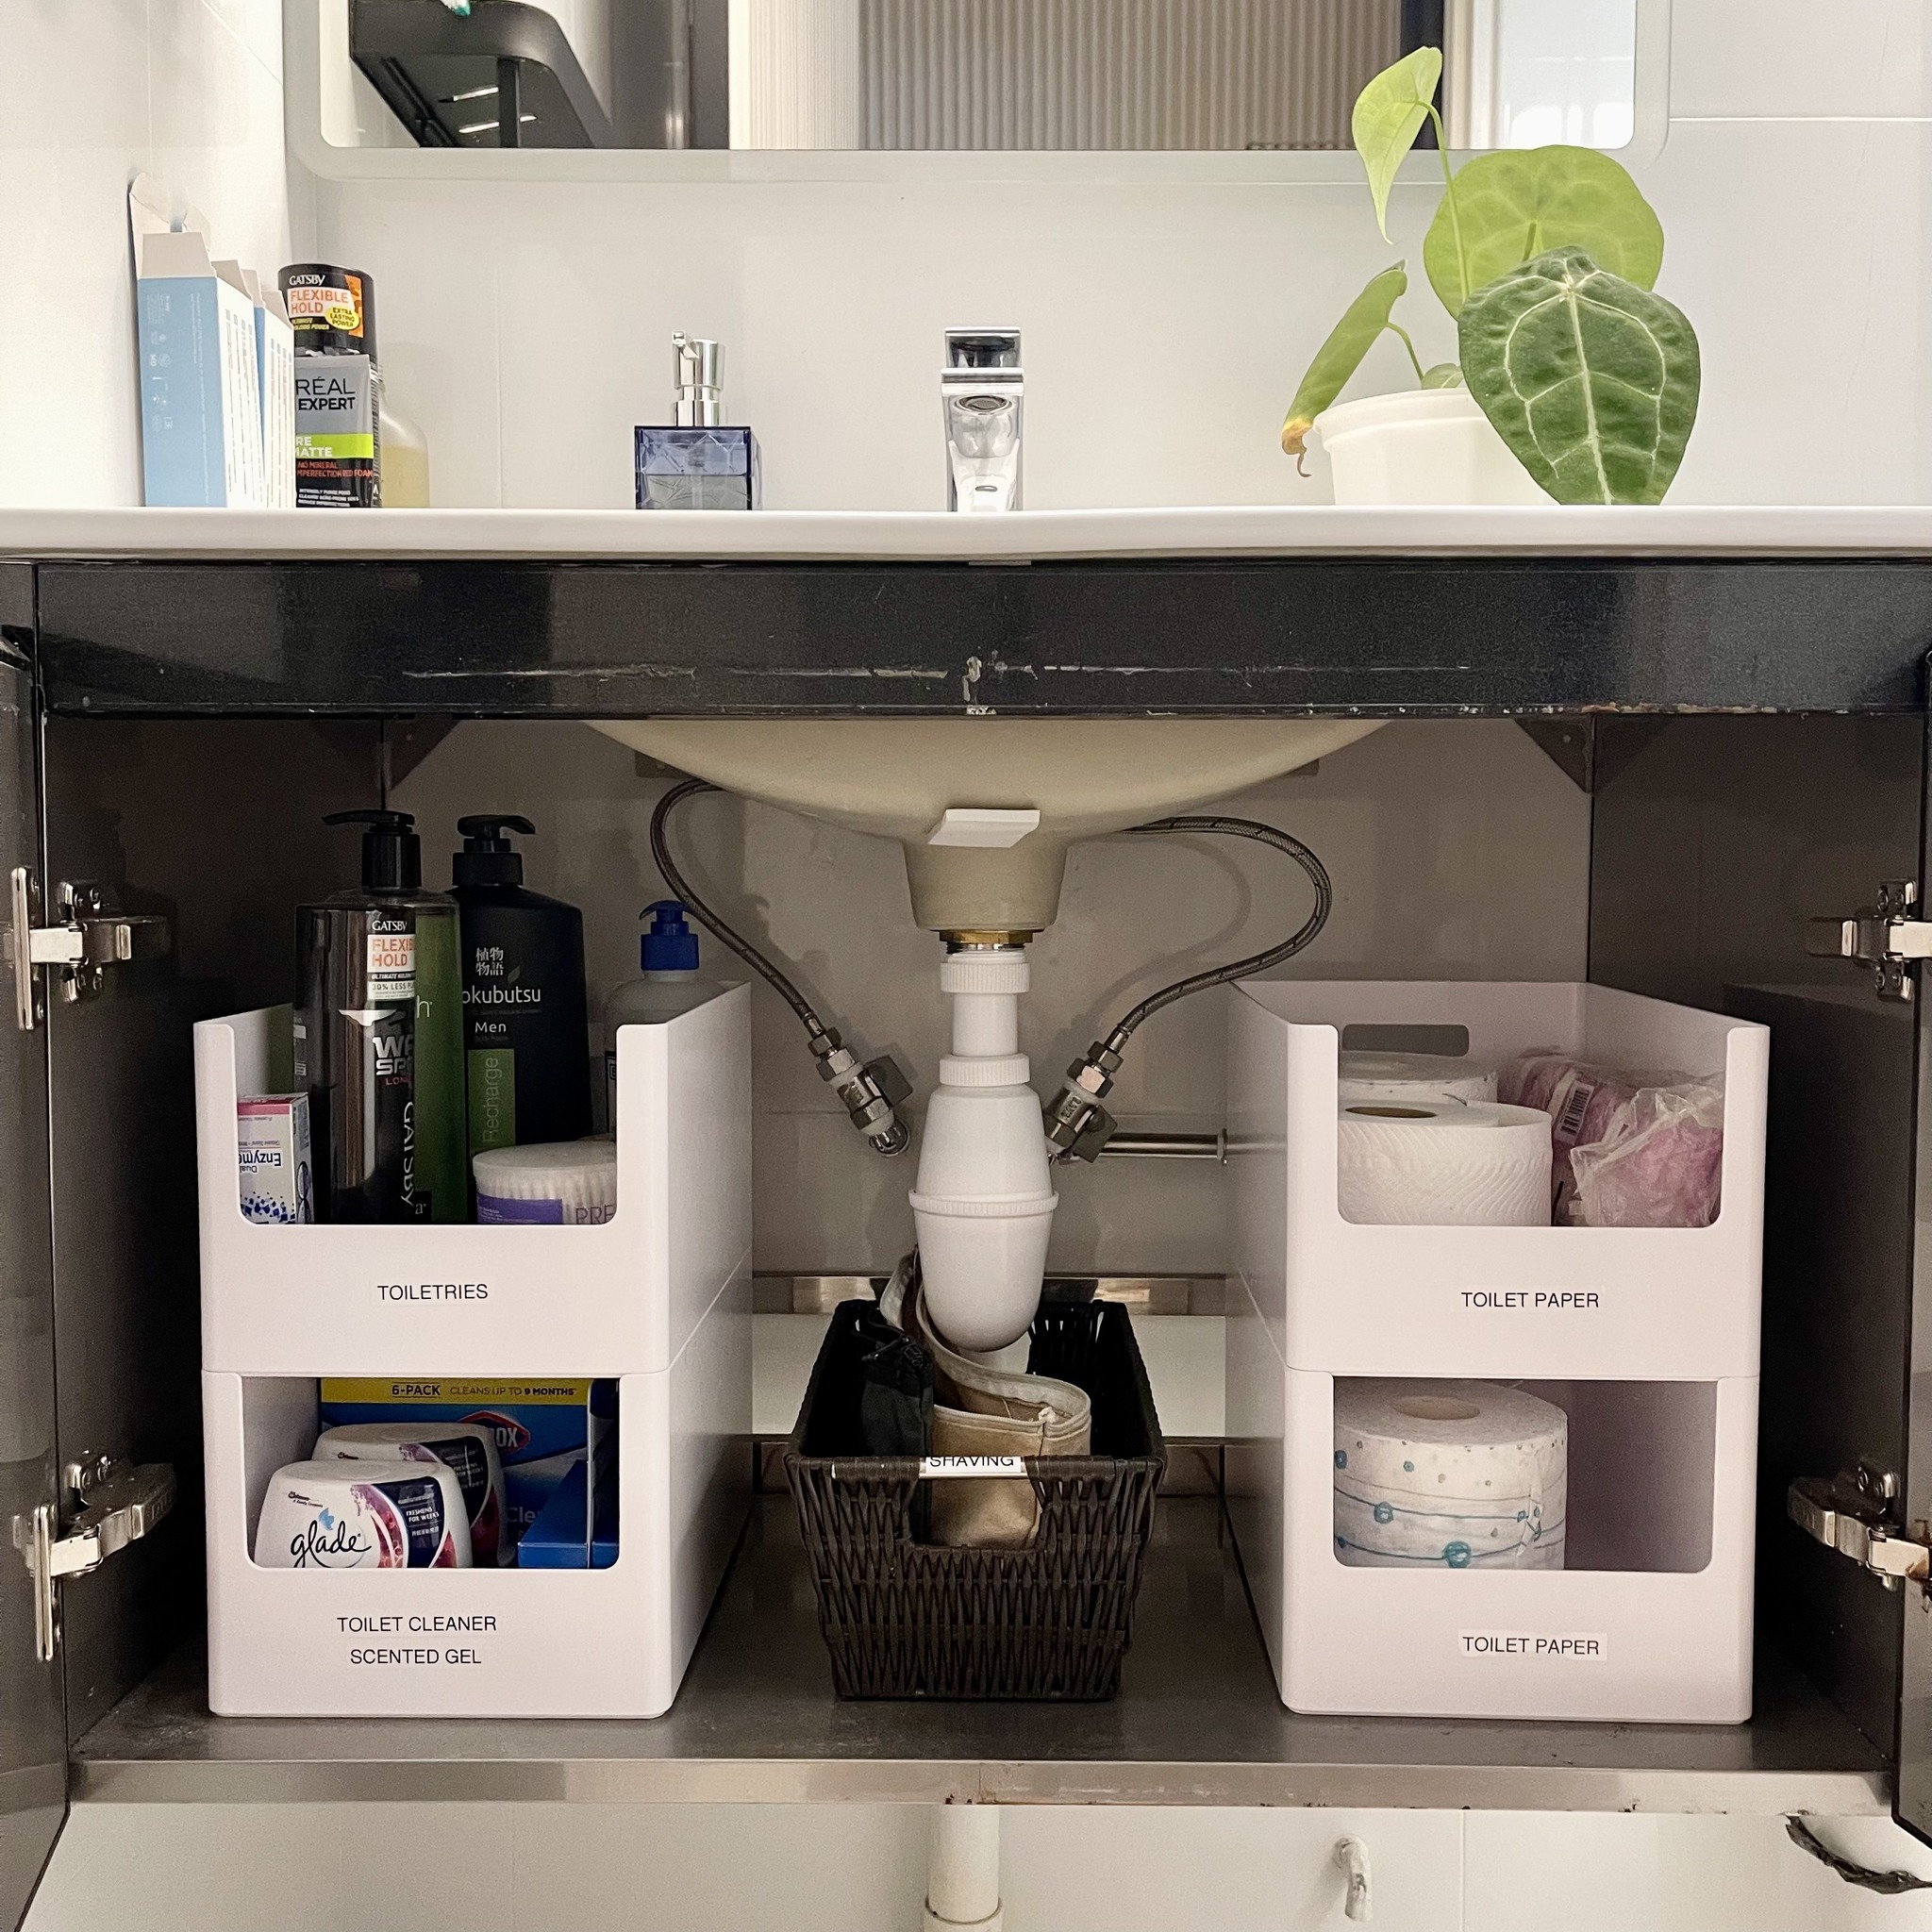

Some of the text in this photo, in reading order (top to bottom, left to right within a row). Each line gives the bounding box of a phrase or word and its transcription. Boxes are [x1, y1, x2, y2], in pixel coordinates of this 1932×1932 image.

[289, 274, 325, 286] GATSBY
[291, 289, 348, 303] FLEXIBLE
[291, 302, 323, 314] HOLD
[298, 396, 356, 410] EXPERT
[372, 920, 408, 932] GATSBY
[373, 954, 408, 967] HOLD
[475, 946, 504, 962] 植物
[391, 982, 406, 991] LESS
[475, 1022, 508, 1033] Men
[482, 1057, 503, 1142] Recharge
[376, 1283, 489, 1301] TOILETRIES
[1460, 1291, 1599, 1308] TOILET PAPER
[391, 1384, 441, 1396] 6-PACK
[449, 1386, 490, 1396] CLEANS
[492, 1387, 506, 1396] UP
[509, 1387, 523, 1396] TO
[524, 1387, 531, 1396] 9
[929, 1456, 1014, 1468] SHAVING
[290, 1519, 373, 1568] glade
[336, 1615, 497, 1633] TOILET CLEANER
[1462, 1636, 1600, 1656] TOILET PAPER
[349, 1648, 482, 1665] SCENTED GEL
